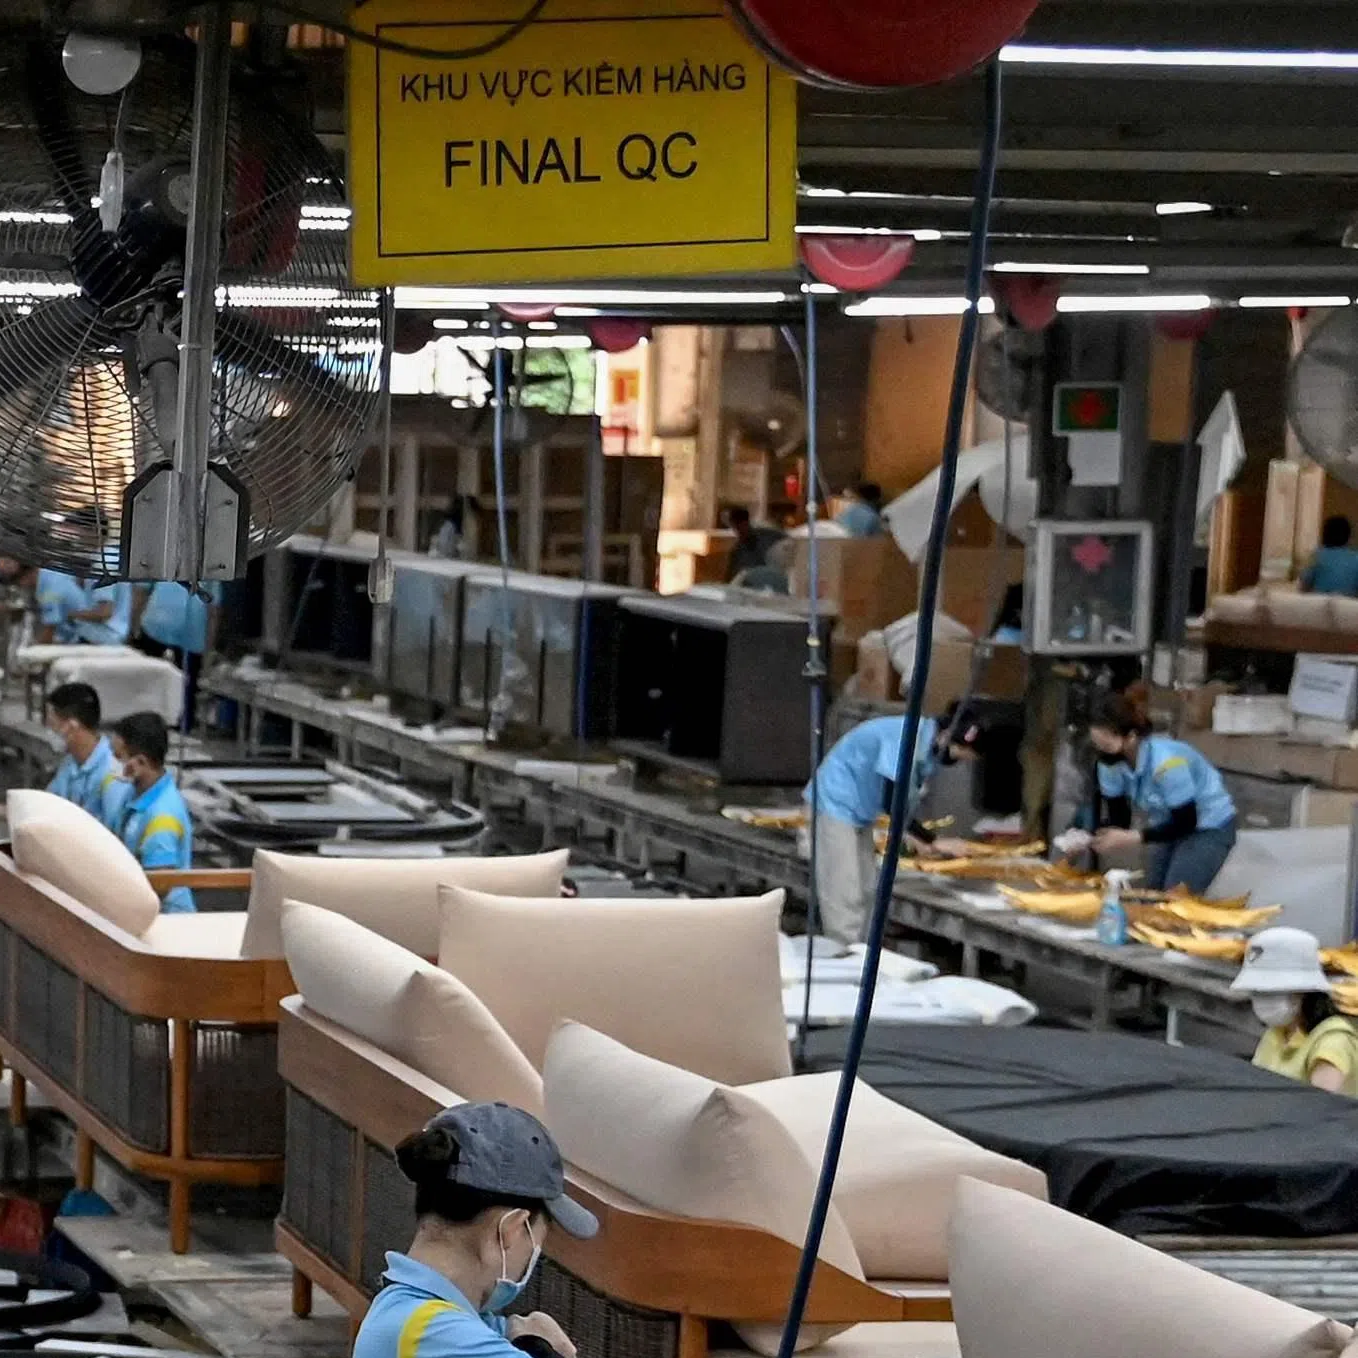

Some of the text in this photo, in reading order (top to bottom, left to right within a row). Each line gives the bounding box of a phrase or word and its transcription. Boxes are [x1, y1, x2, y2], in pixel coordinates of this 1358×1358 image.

[400, 72, 468, 103] KHU
[480, 68, 552, 107] VỰC
[653, 59, 746, 94] HÀNG
[444, 131, 698, 188] FINAL QC
